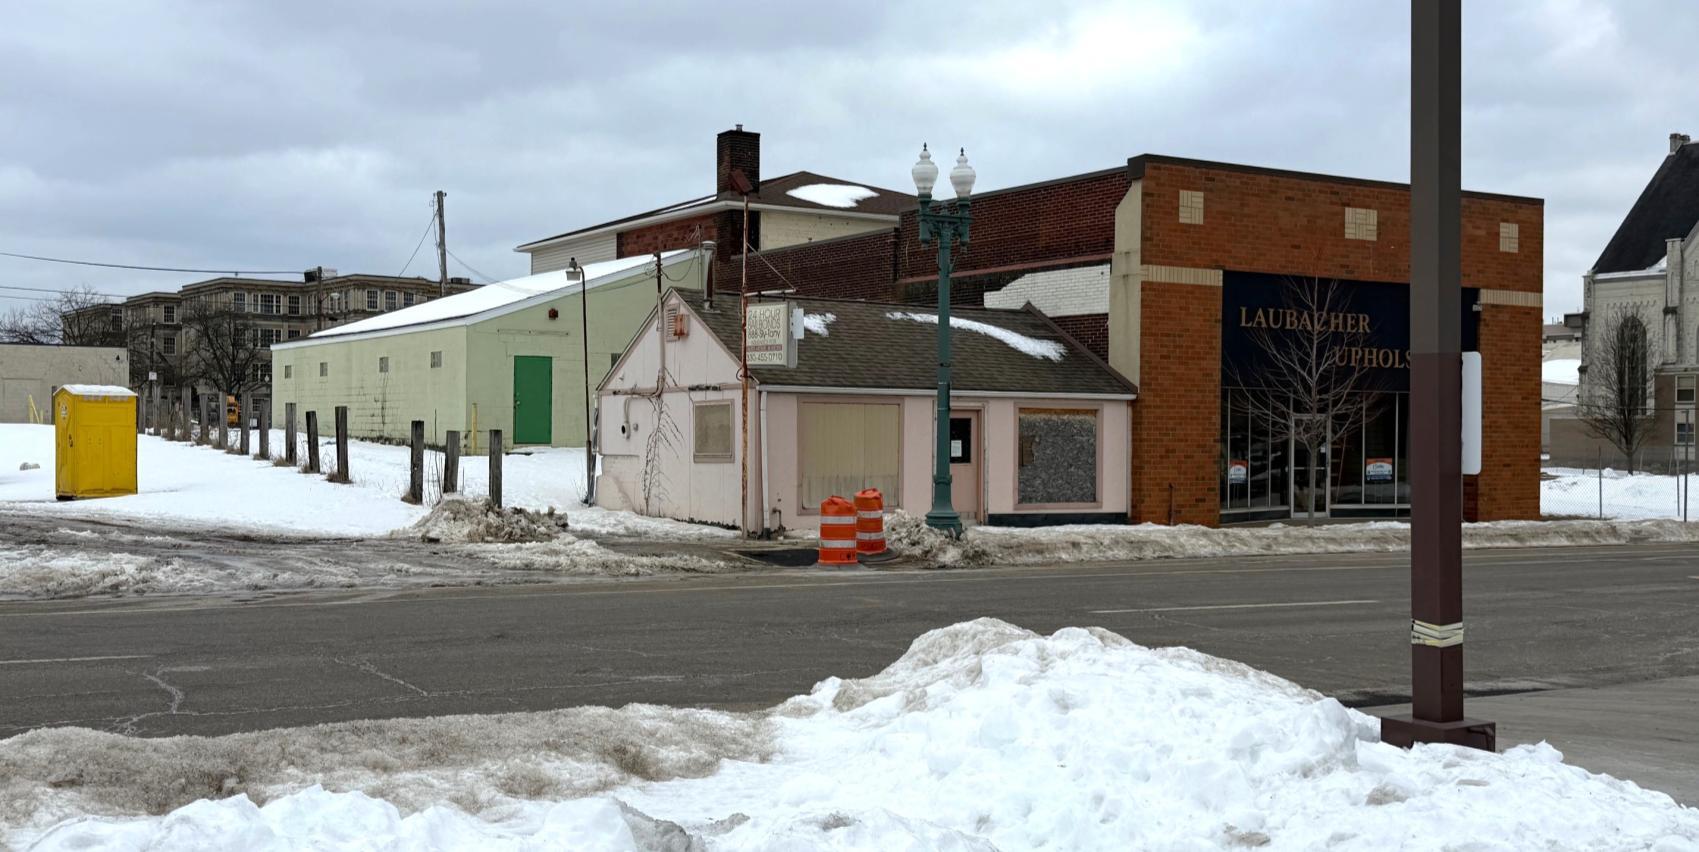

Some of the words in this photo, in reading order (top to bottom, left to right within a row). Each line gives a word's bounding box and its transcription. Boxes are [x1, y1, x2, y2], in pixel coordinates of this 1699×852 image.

[748, 311, 757, 320] 24
[760, 308, 780, 319] HOUR
[1240, 306, 1371, 333] LAUBACHER
[759, 319, 780, 329] BONDS
